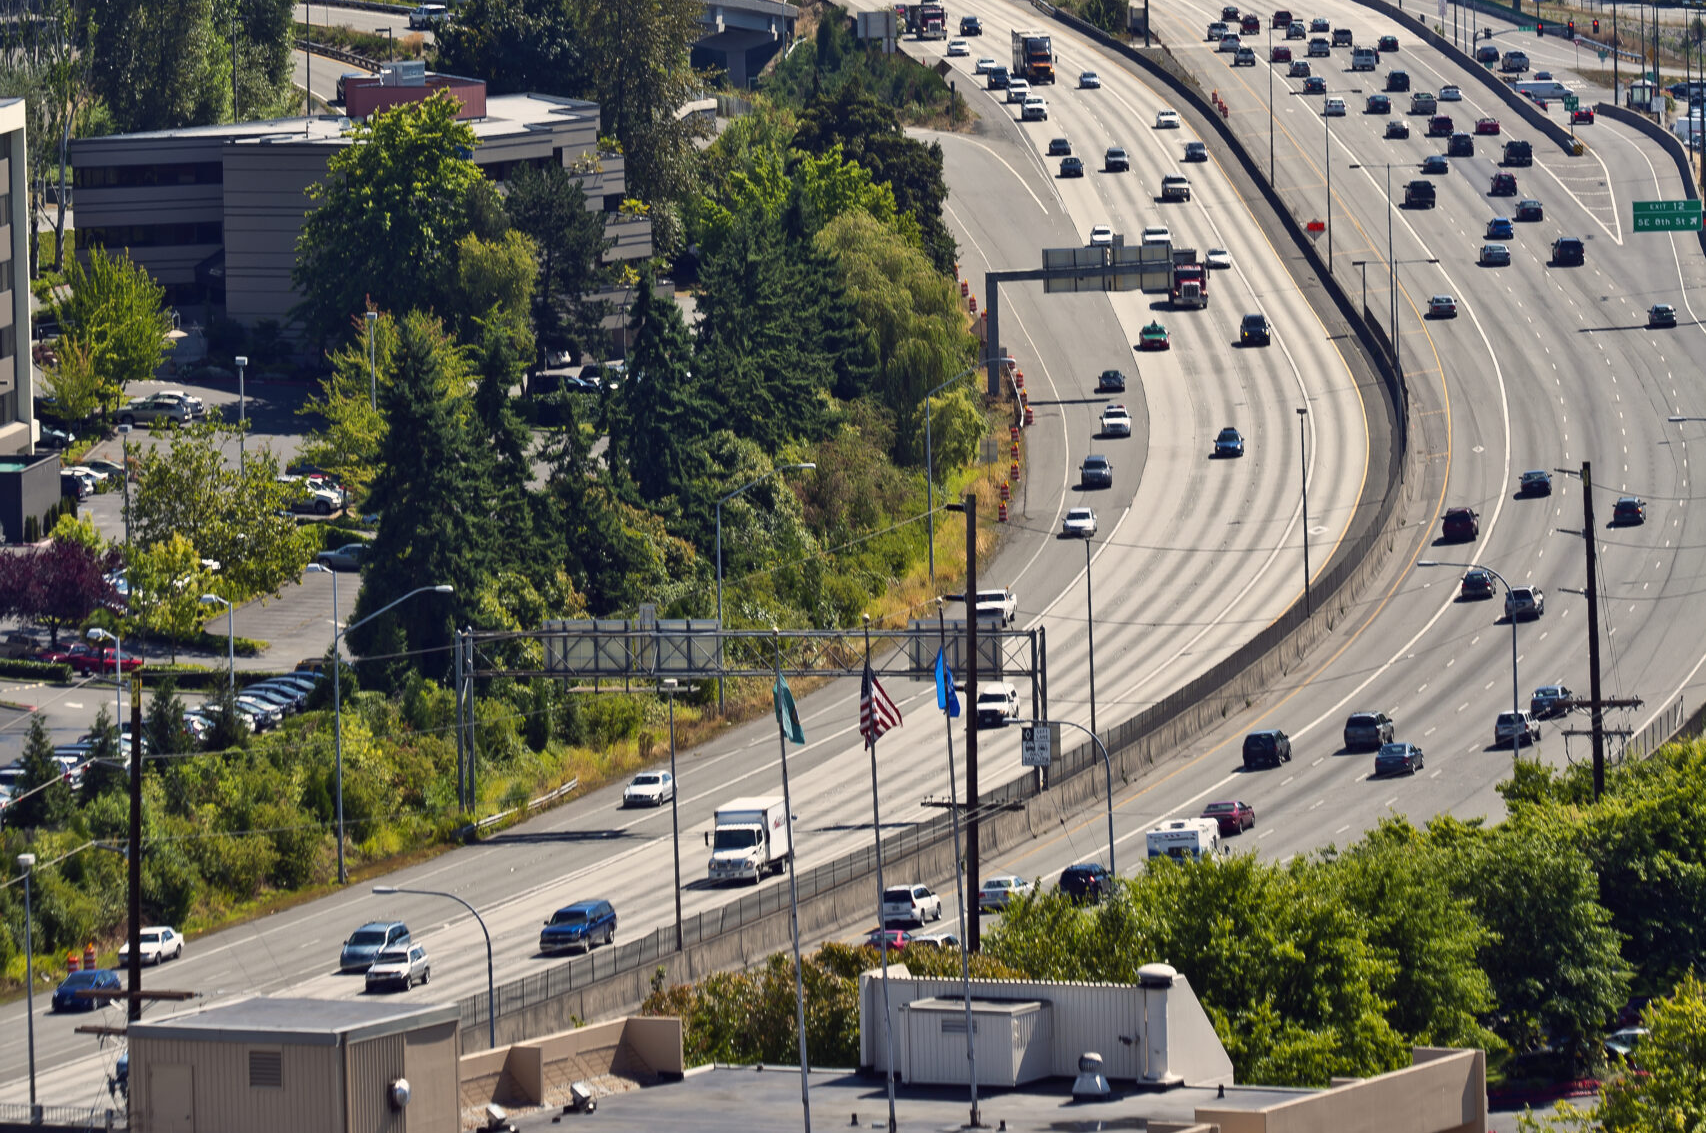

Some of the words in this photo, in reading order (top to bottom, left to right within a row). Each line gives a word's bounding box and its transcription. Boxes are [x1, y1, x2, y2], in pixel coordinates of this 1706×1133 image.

[1673, 201, 1685, 211] 12
[1638, 218, 1650, 226] SE
[1675, 216, 1686, 225] St
